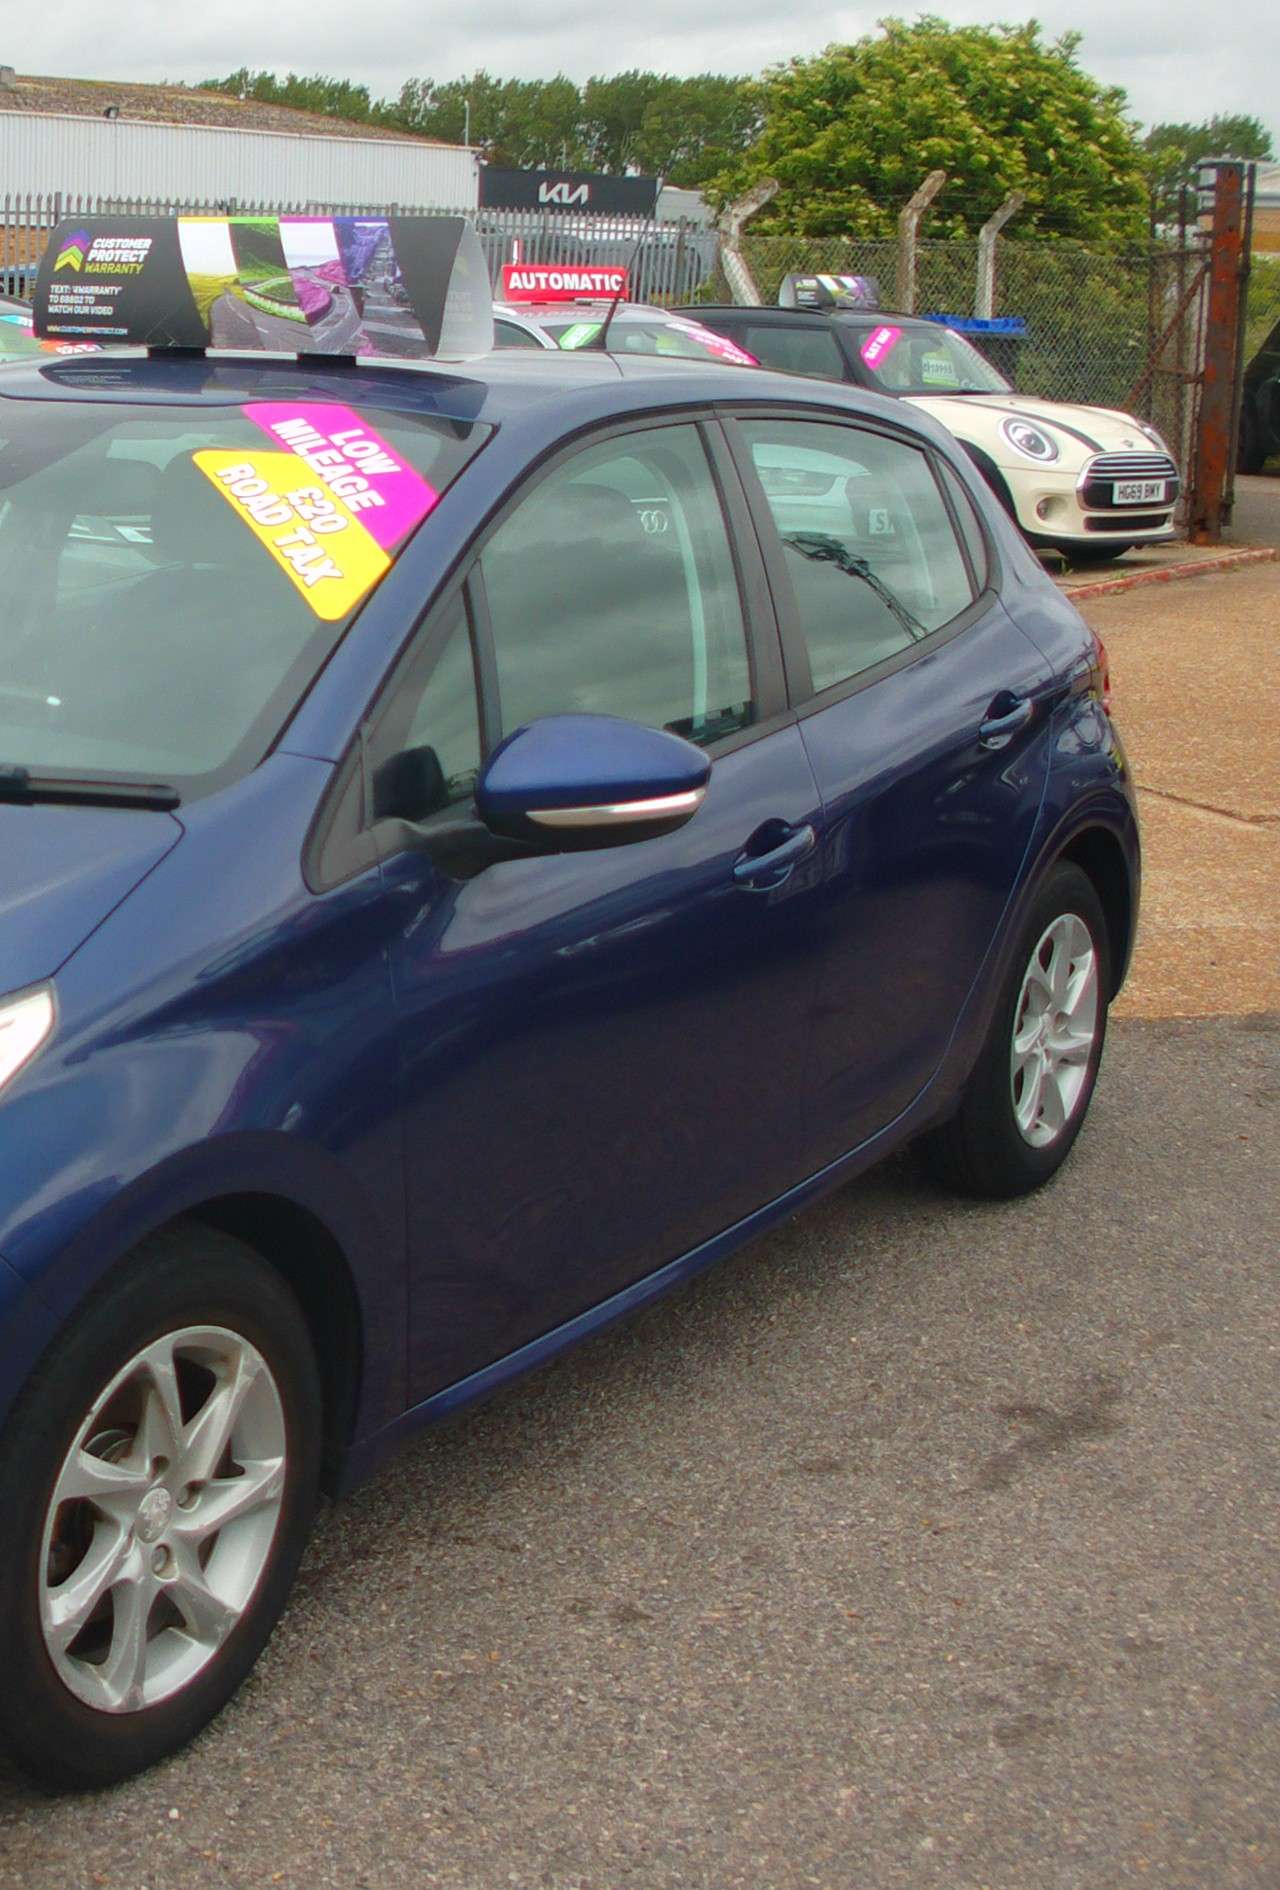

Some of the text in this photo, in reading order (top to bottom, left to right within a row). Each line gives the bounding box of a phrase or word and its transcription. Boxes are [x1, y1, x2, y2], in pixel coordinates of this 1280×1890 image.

[538, 181, 589, 205] KIA
[87, 249, 148, 262] PROTECT
[92, 238, 152, 249] CUSTOMER
[84, 263, 144, 274] WARRANTY
[508, 272, 624, 292] AUTOMATIC
[328, 428, 402, 475] LOW
[270, 417, 387, 513] MILEAGE
[285, 485, 350, 535] £20
[214, 462, 346, 589] ROAD TAX
